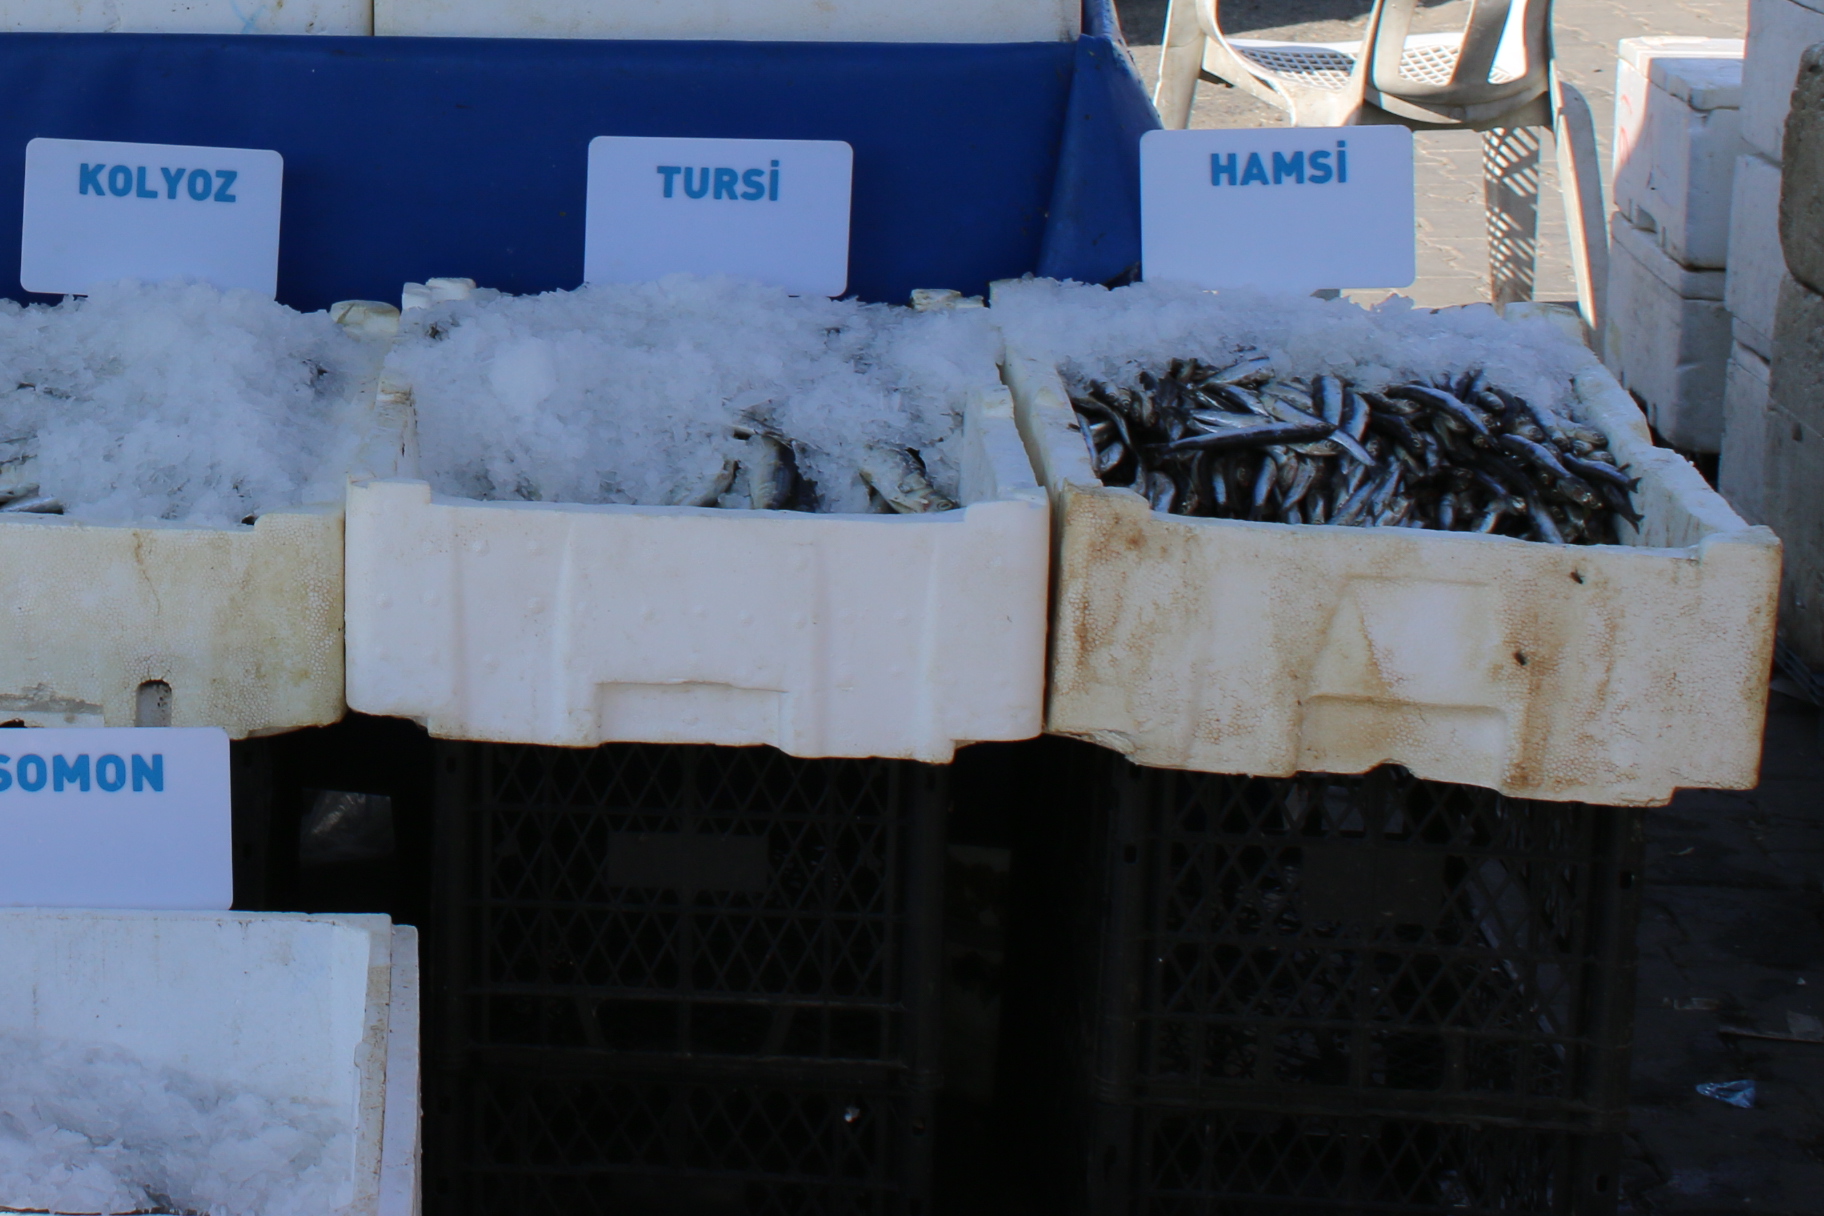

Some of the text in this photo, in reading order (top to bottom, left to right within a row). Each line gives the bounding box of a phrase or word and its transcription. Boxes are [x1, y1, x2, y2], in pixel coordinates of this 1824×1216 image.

[78, 163, 238, 203] KOLYOZ
[656, 159, 780, 201] TURSİ
[1210, 140, 1347, 186] HAMSİ
